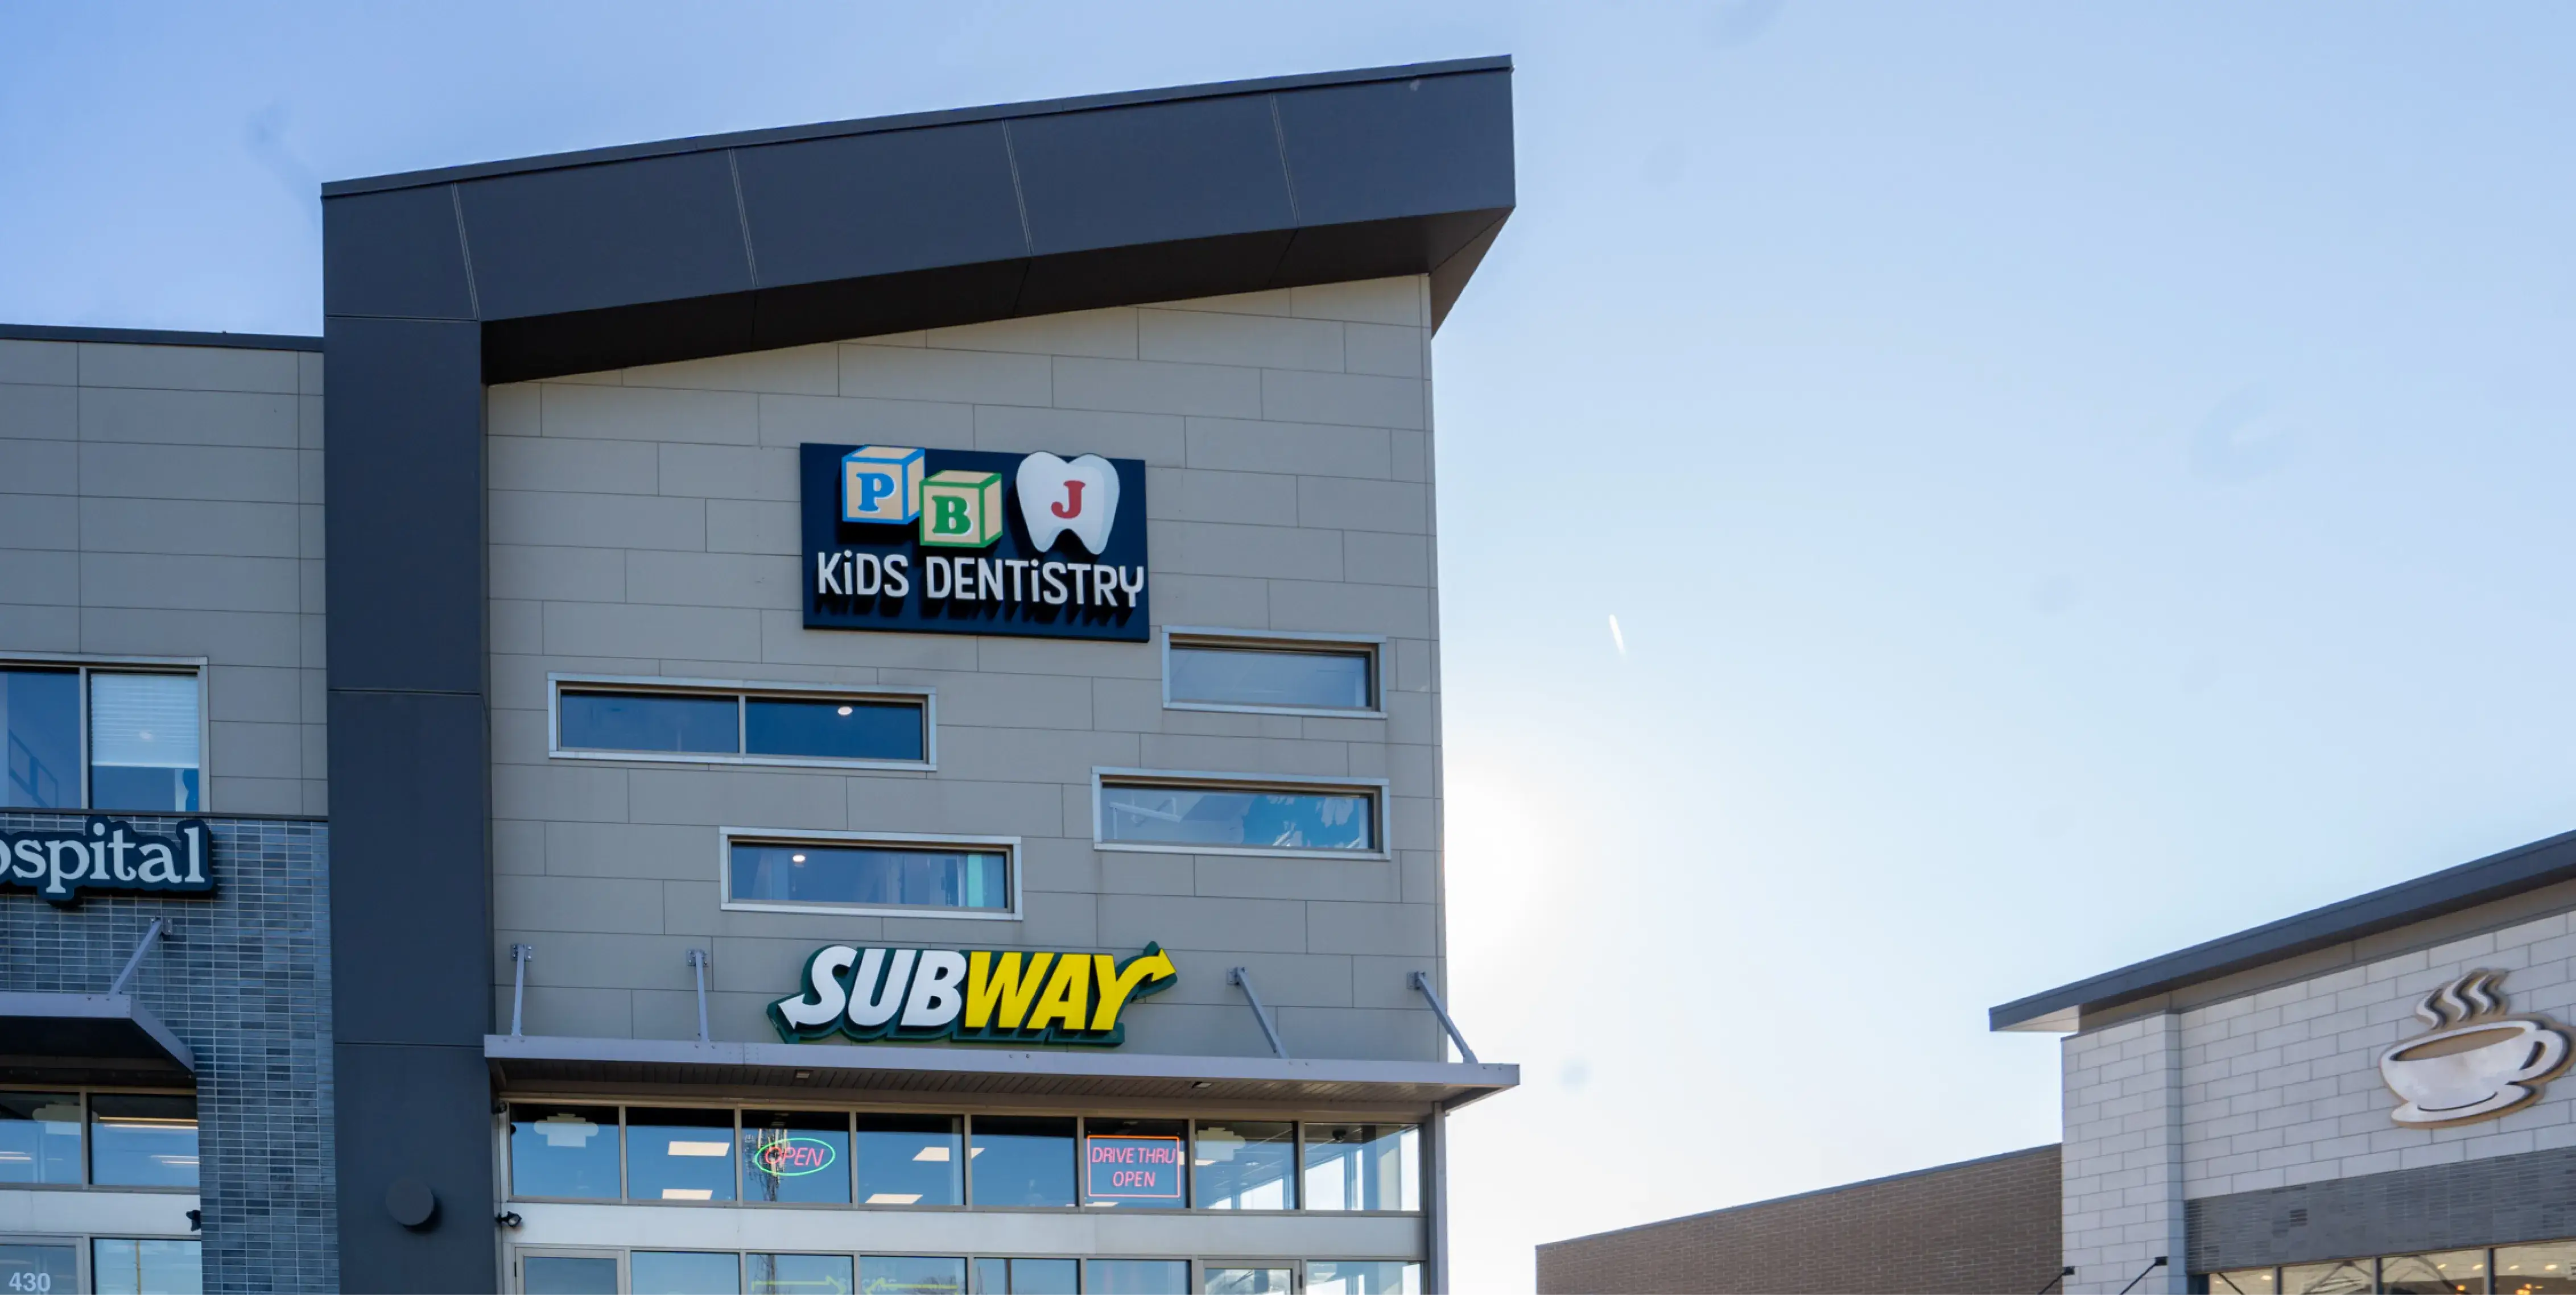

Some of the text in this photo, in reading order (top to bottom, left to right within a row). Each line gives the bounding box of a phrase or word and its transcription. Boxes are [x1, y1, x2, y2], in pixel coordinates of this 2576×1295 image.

[856, 471, 1086, 537] P B J
[778, 945, 1178, 1032] SUBWAY
[764, 1146, 824, 1167] OPEN
[1091, 1147, 1176, 1164] DRIVE THRU
[1112, 1170, 1156, 1188] OPEN
[8, 1272, 51, 1292] 430
